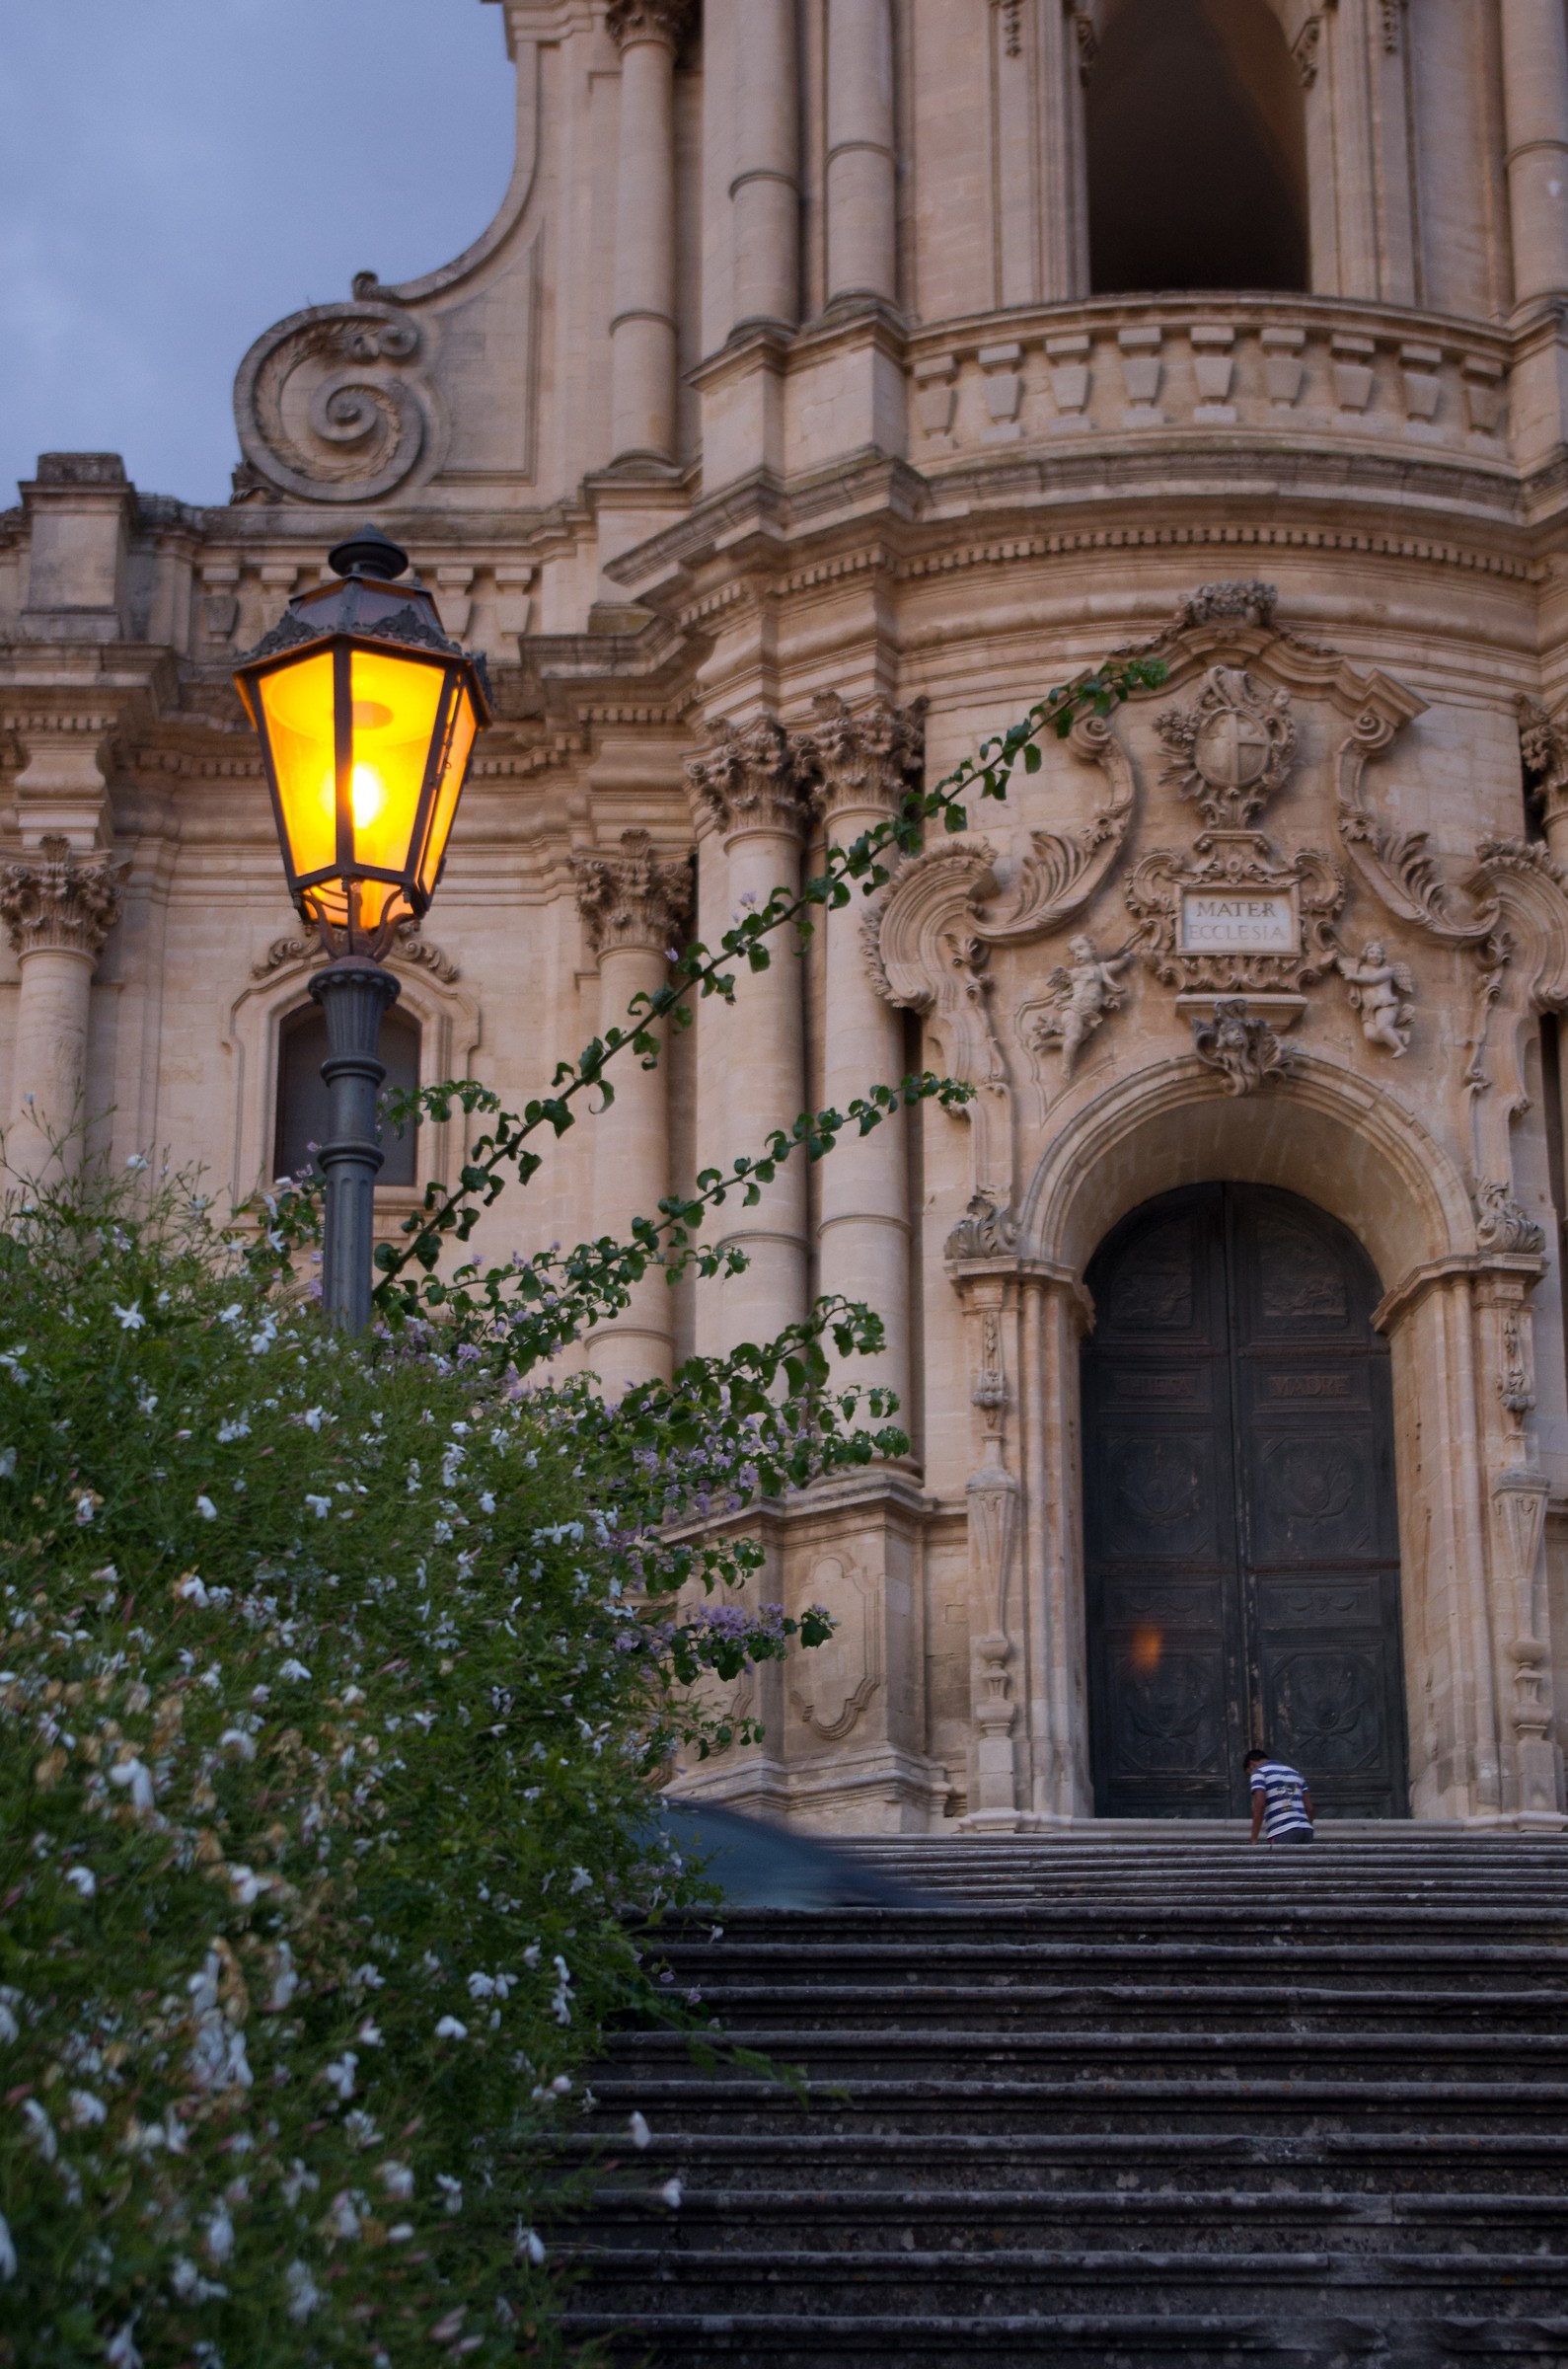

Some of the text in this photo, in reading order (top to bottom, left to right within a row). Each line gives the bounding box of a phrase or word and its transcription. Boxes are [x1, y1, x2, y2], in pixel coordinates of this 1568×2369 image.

[1196, 900, 1277, 918] MATER
[1187, 924, 1289, 941] ECCLESIA
[1115, 1375, 1351, 1398] CHIESA MADRE
